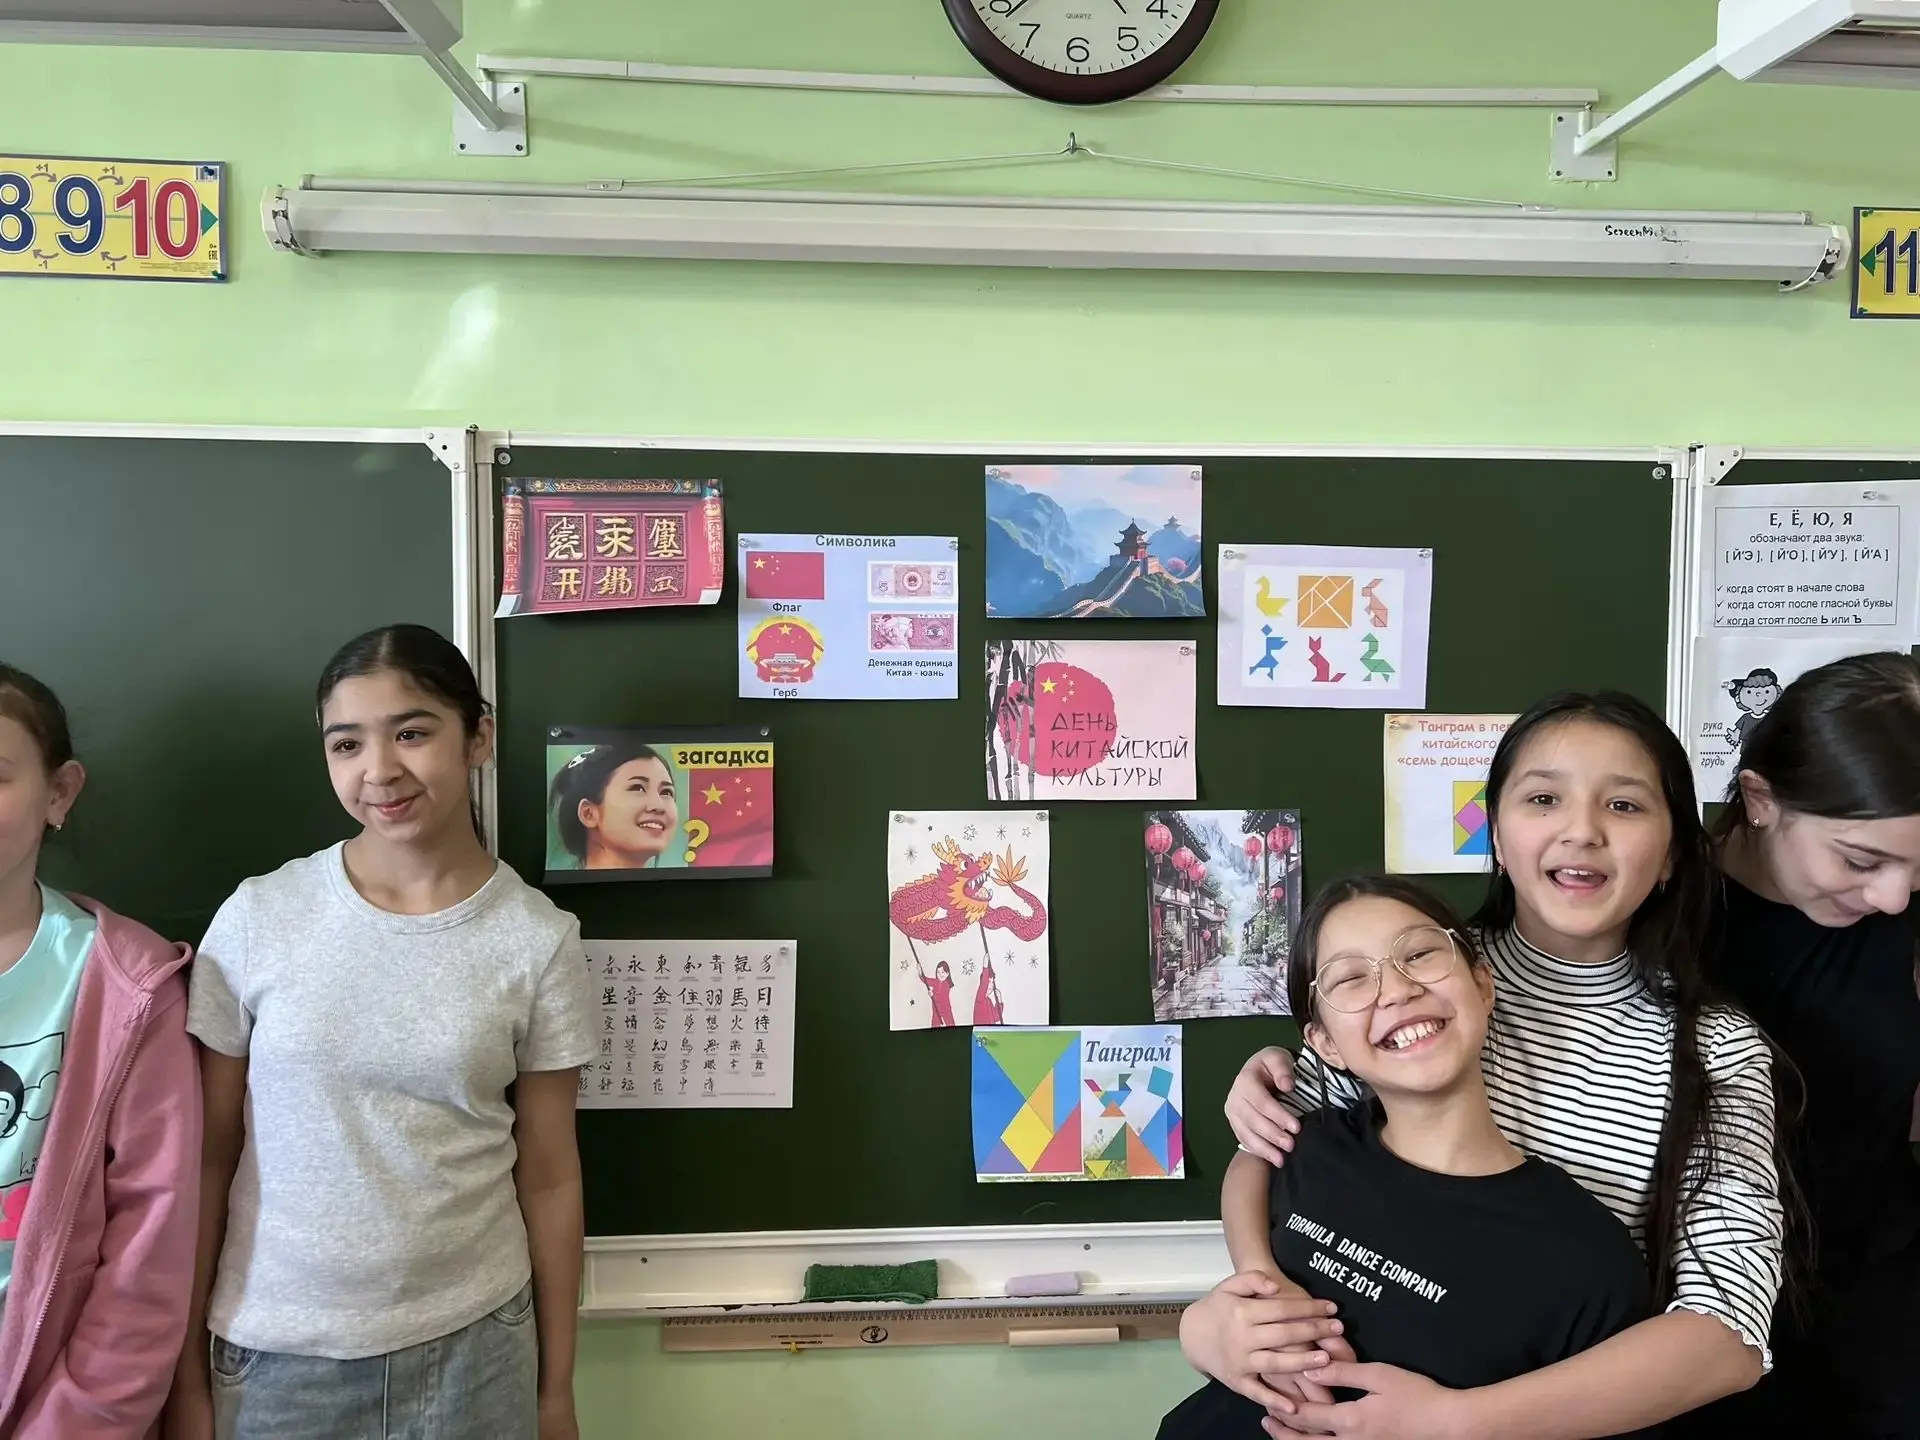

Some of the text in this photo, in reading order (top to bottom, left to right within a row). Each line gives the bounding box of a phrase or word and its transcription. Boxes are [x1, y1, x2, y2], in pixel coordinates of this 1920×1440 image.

[1019, 23, 1041, 48] 7
[1117, 27, 1139, 51] 5
[1066, 37, 1089, 62] 6
[0, 172, 201, 260] 8 9 10
[1875, 228, 1919, 296] 11
[1842, 512, 1853, 526] Я
[815, 535, 896, 547] Символика
[1750, 533, 1864, 543] обозначают два звука:
[1727, 584, 1753, 593] когда
[1757, 584, 1785, 592] стоят
[1797, 584, 1832, 592] начале
[772, 603, 802, 612] Флаг
[1728, 598, 1893, 609] когда стоят после гласной буквы
[1727, 616, 1754, 625] когда
[1757, 616, 1785, 624] стоят
[1789, 616, 1817, 624] после
[1832, 616, 1850, 624] или
[868, 658, 953, 668] Денежная единица
[886, 669, 912, 677] Китая
[773, 688, 798, 698] Герб
[1051, 712, 1117, 732] ДЕНЬ
[1418, 720, 1474, 735] Танграм
[1479, 723, 1485, 732] в
[1702, 721, 1723, 731] рука
[1051, 735, 1188, 759] КИТАЙСКОЙ
[1422, 738, 1497, 749] китайского
[678, 749, 769, 767] загадка
[1440, 756, 1493, 767] дощече
[1701, 756, 1725, 768] грудь
[1052, 767, 1162, 787] КУЛЬТУРЫ
[627, 955, 646, 974] 永
[655, 954, 671, 974] 東
[710, 954, 726, 974] 青
[602, 988, 618, 1006] 星
[652, 986, 672, 1005] 金
[731, 988, 748, 1007] 馬
[731, 1015, 744, 1031] 火
[1085, 1040, 1172, 1067] Танграм
[1286, 1213, 1447, 1303] FORMULA DANCE COMPANY
[1309, 1252, 1383, 1302] SINCE 2014
